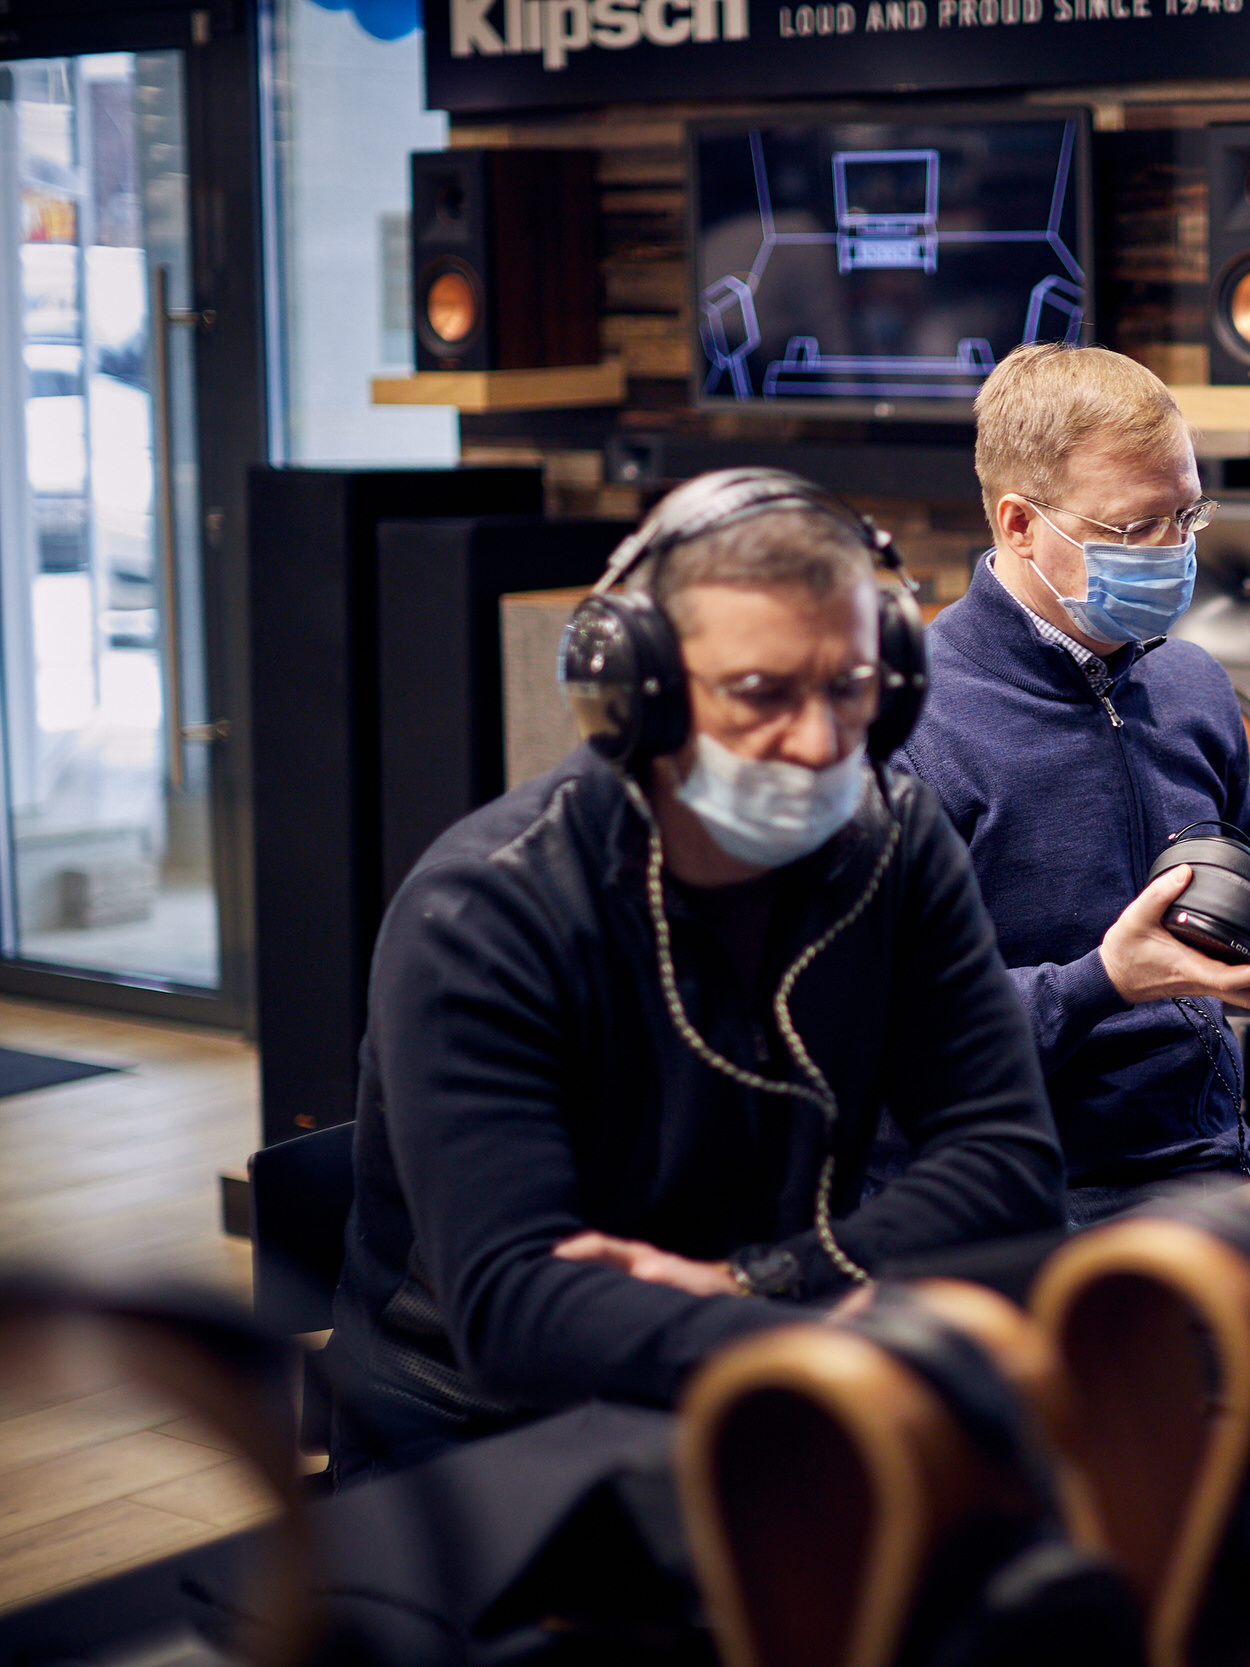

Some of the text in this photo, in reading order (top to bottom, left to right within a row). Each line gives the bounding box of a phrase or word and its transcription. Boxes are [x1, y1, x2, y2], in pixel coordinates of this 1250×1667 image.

[779, 4, 856, 37] LOUD
[865, 0, 926, 32] AND
[938, 0, 1043, 27] PROUD
